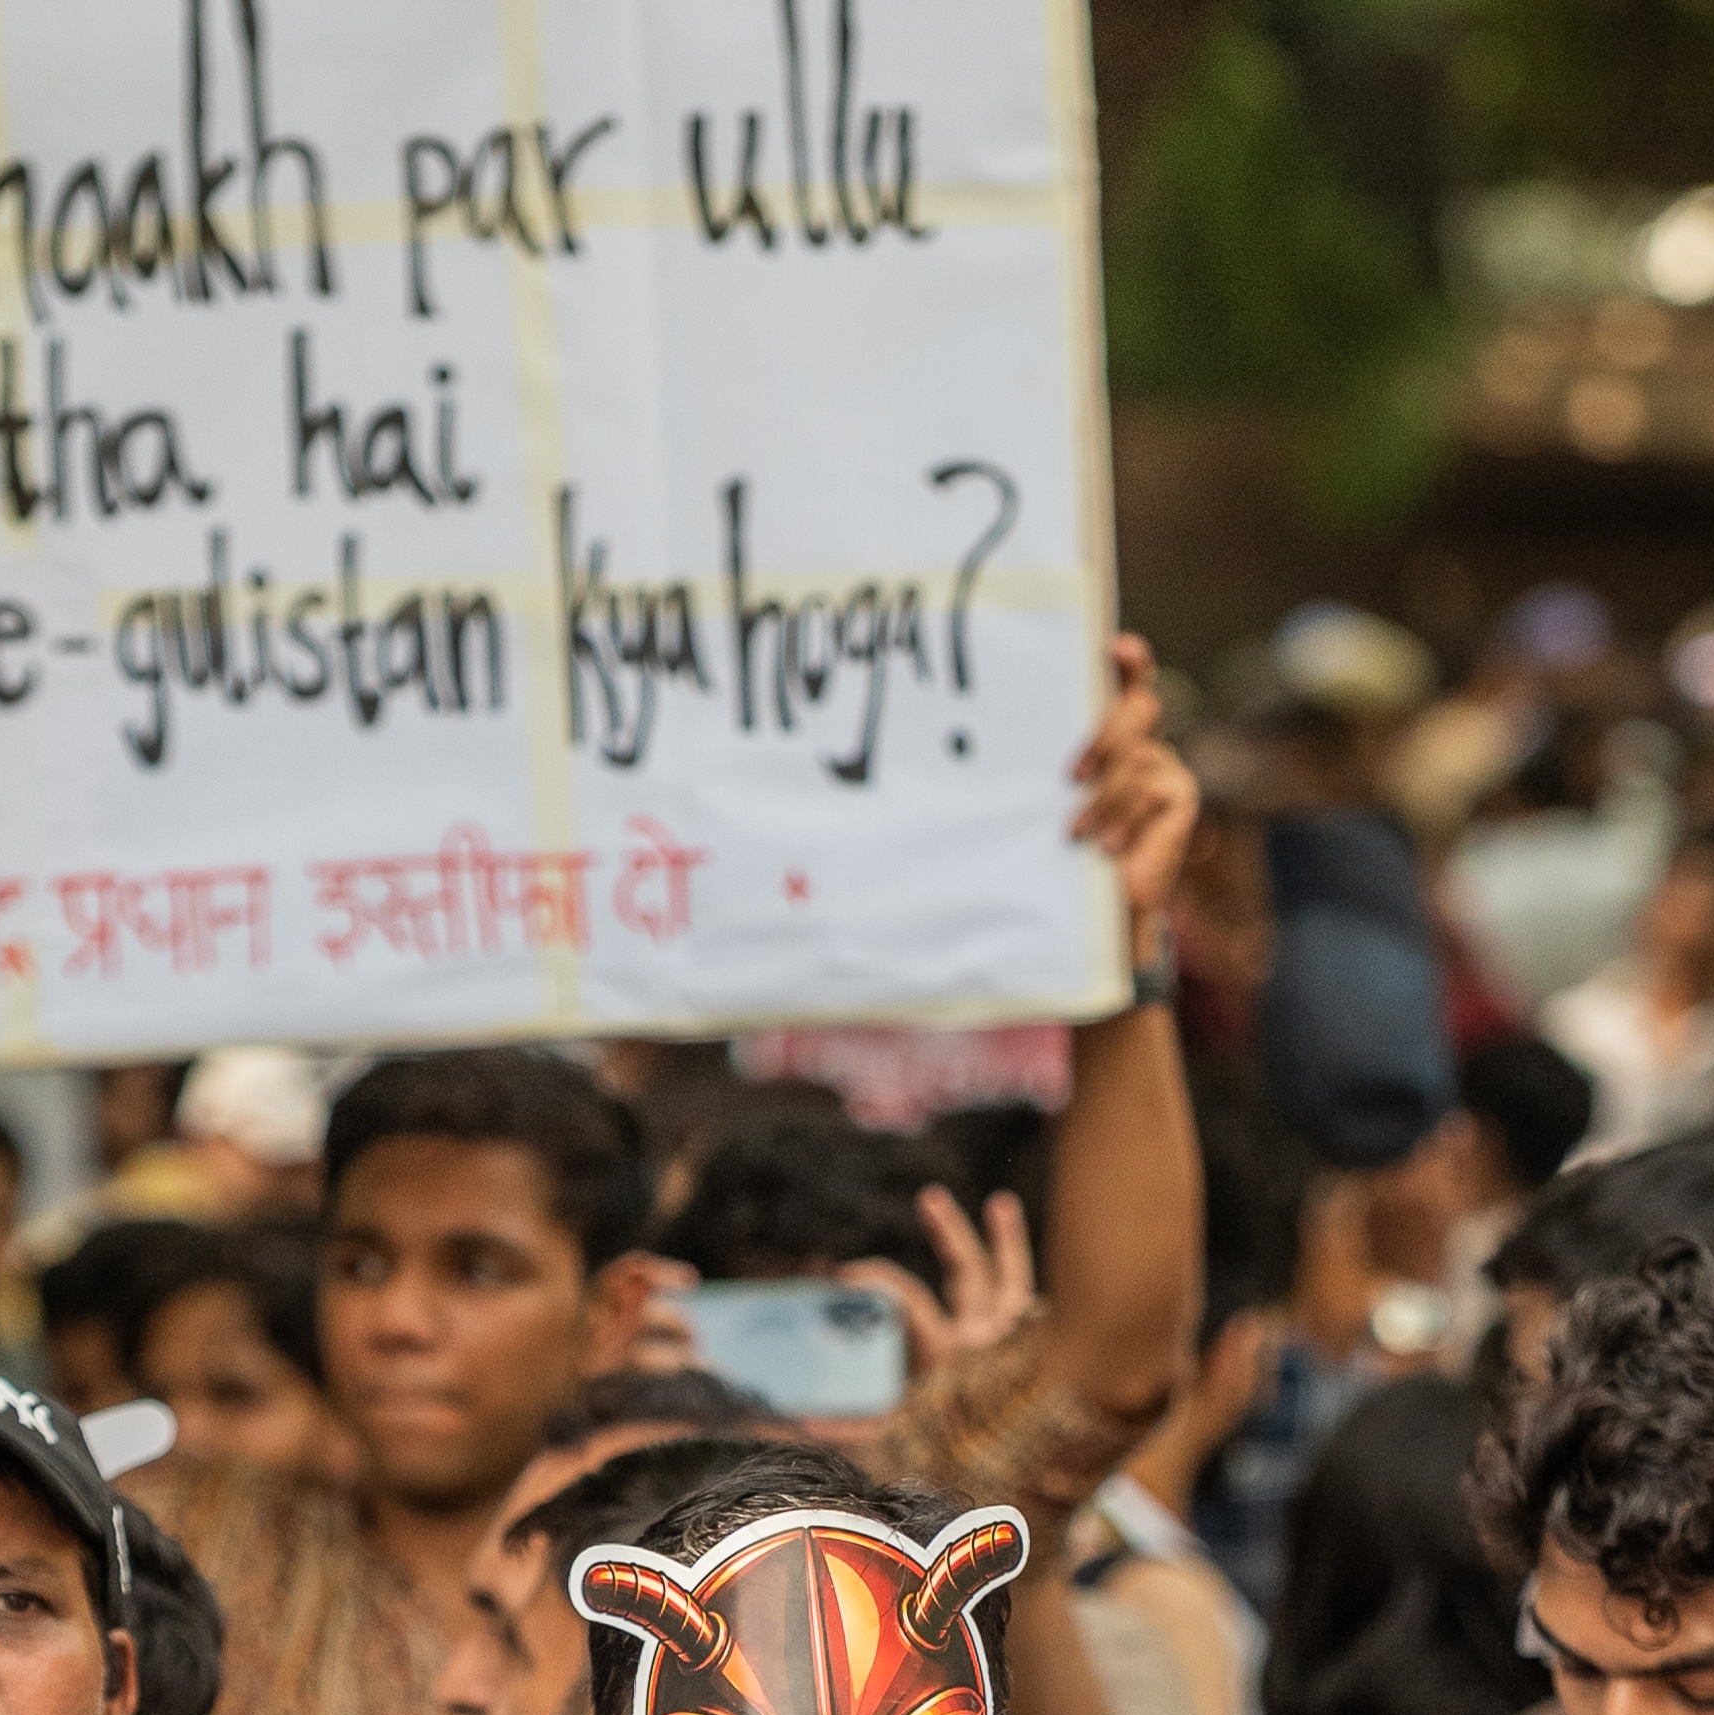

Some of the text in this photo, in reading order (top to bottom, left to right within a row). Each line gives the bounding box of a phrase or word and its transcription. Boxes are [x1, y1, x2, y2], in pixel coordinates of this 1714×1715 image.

[402, 113, 619, 320] par
[687, 0, 937, 252] ullu
[290, 326, 478, 506] hai
[717, 462, 1021, 785] hoga?
[49, 864, 272, 984] प्रधान
[612, 812, 717, 946] दो
